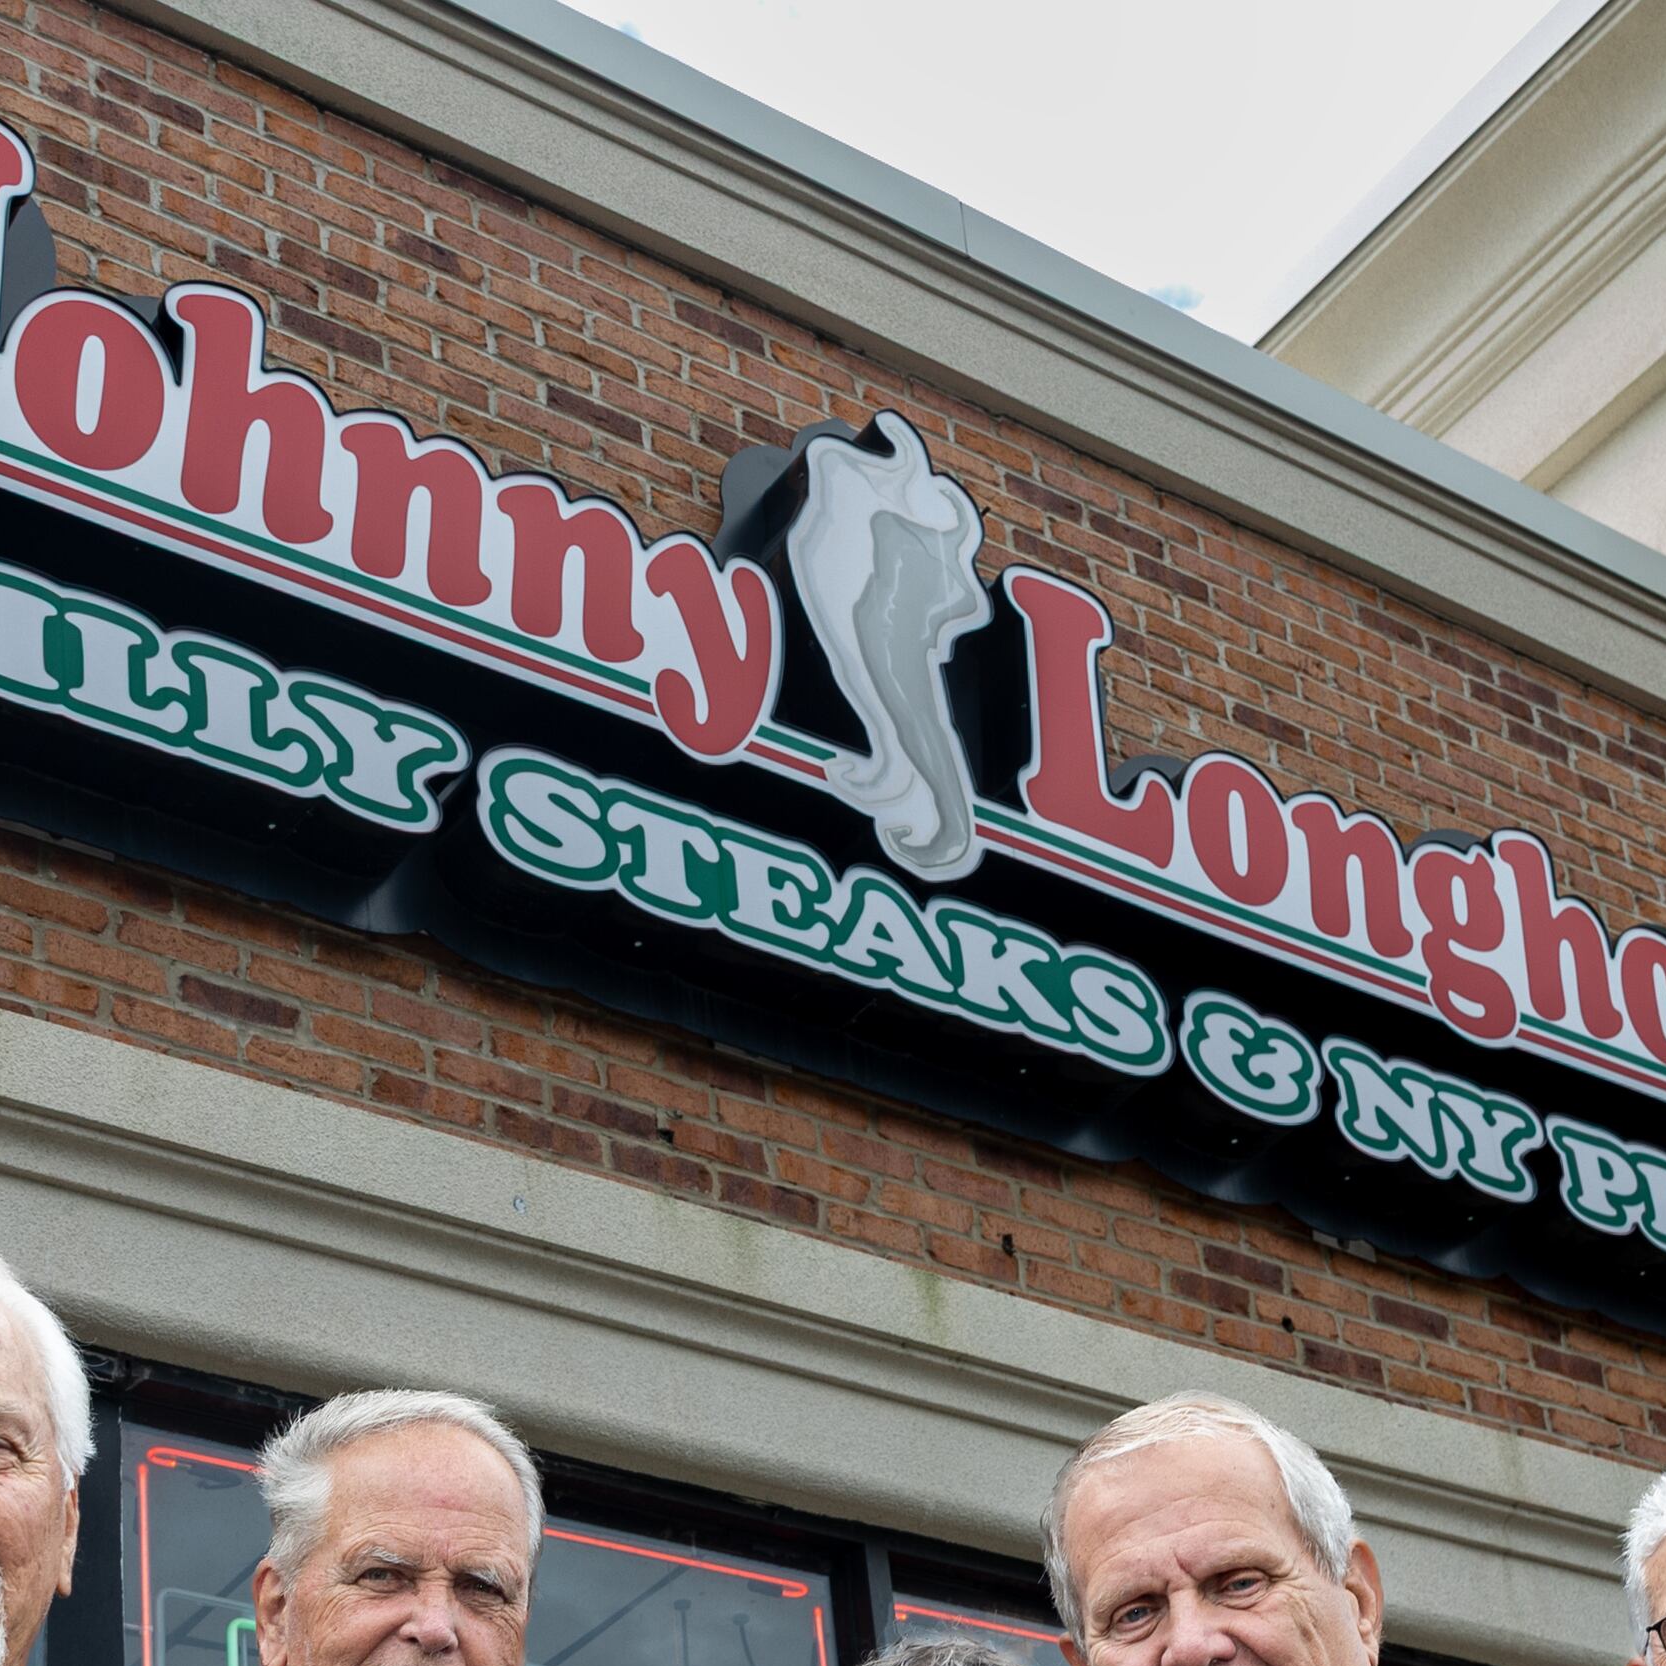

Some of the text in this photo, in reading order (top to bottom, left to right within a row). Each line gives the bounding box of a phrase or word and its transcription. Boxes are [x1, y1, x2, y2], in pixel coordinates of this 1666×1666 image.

[485, 752, 1168, 1075] STEAKS
[1191, 1003, 1315, 1117] &
[1331, 1046, 1535, 1194] NY
